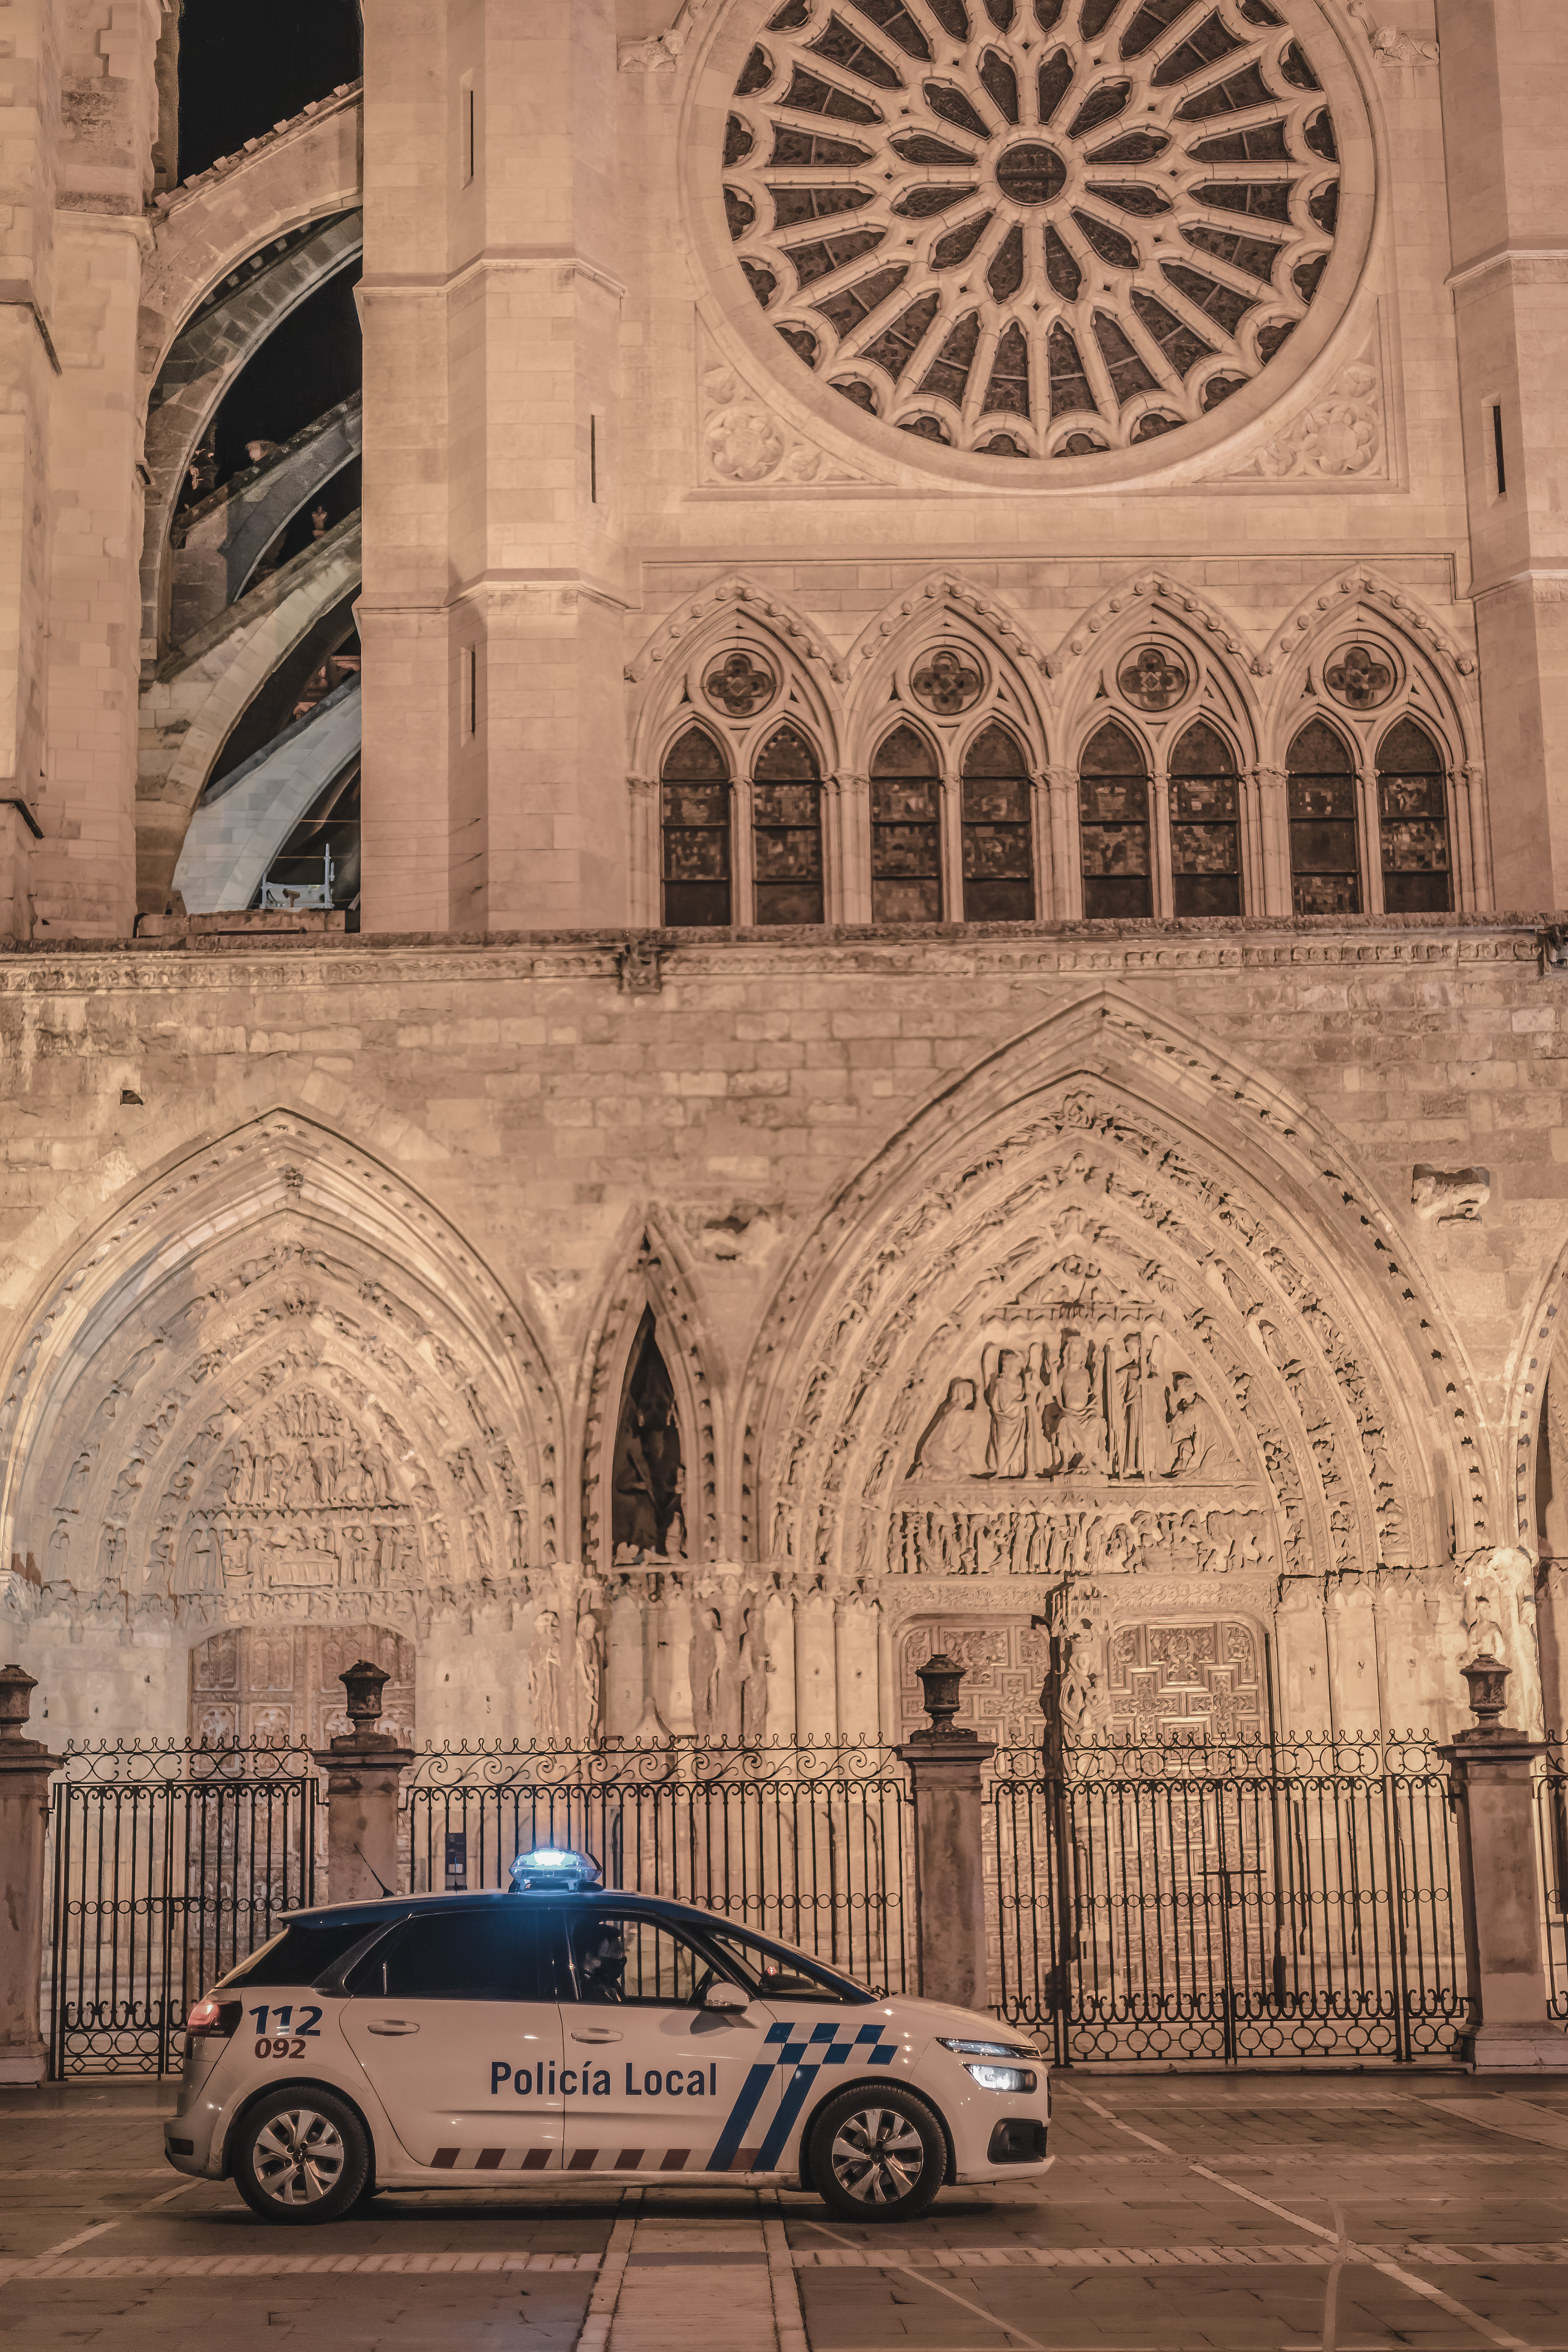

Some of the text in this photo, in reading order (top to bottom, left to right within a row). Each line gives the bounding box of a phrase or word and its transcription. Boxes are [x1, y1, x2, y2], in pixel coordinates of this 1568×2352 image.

[248, 2005, 323, 2036] 112
[255, 2038, 306, 2058] 092
[491, 2060, 716, 2096] Policía Local
